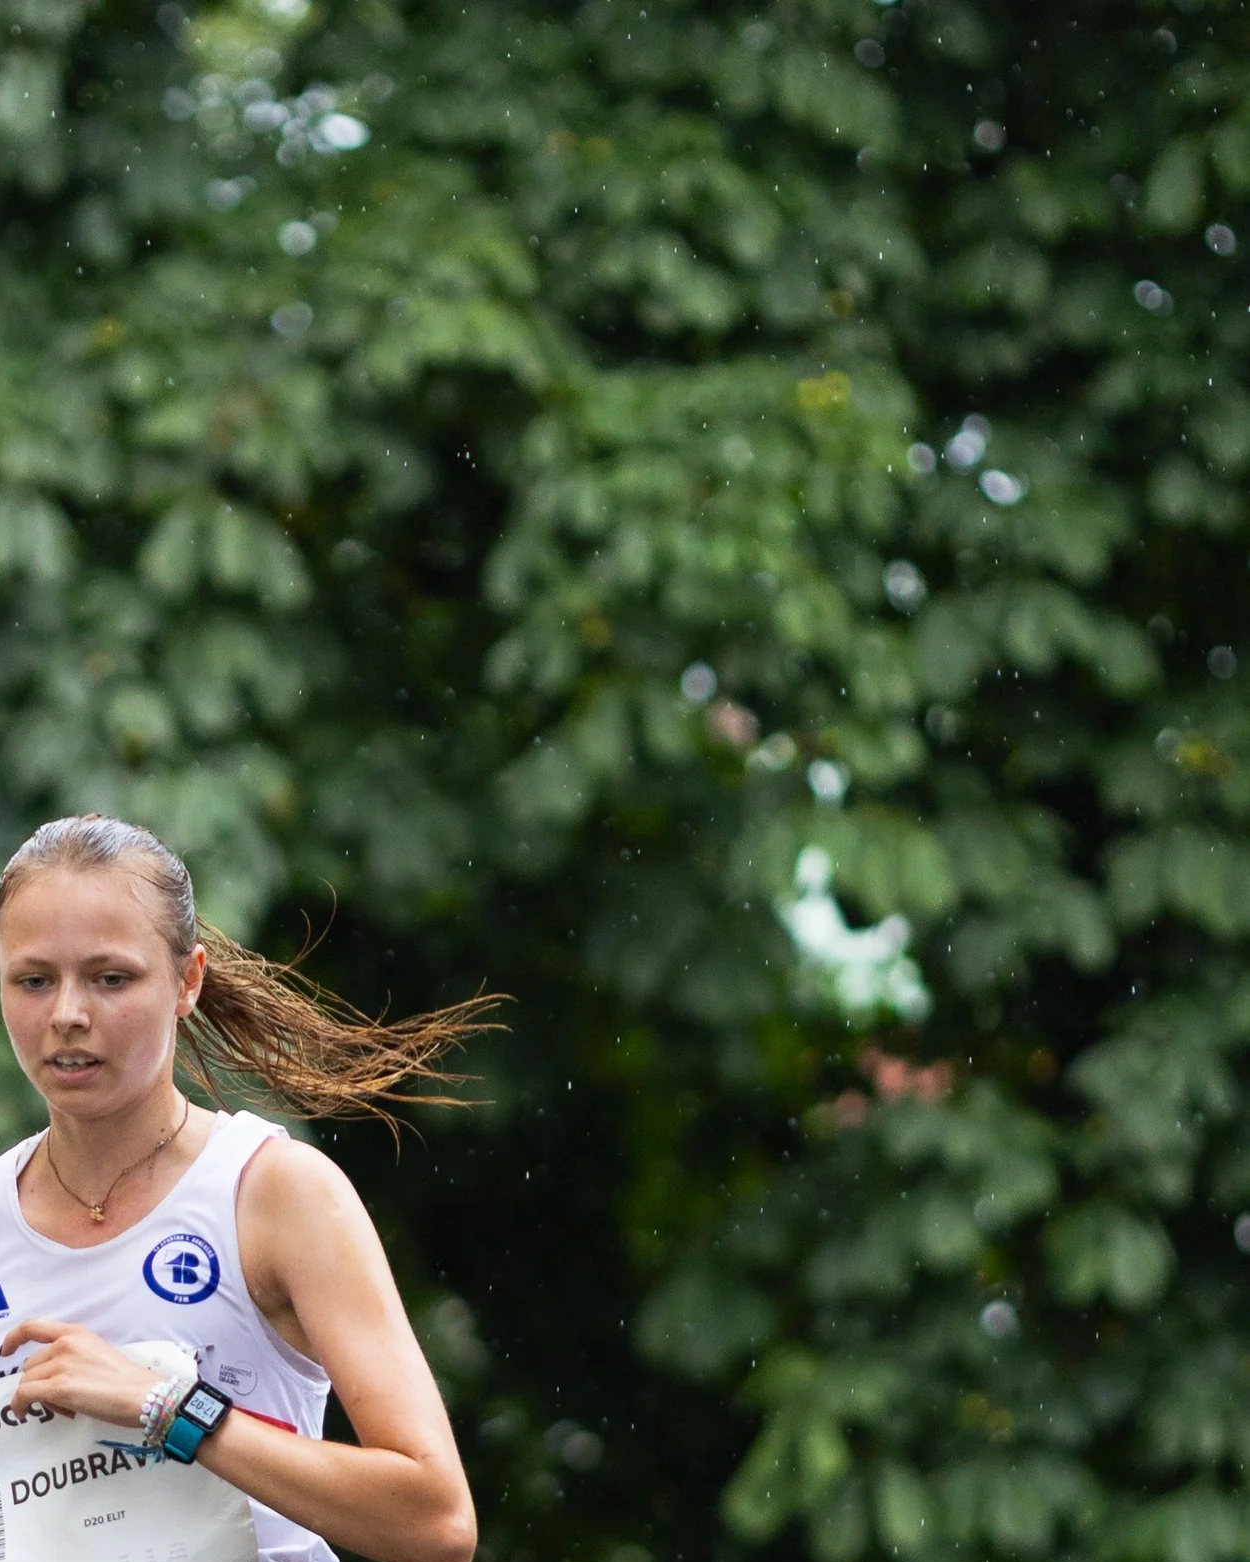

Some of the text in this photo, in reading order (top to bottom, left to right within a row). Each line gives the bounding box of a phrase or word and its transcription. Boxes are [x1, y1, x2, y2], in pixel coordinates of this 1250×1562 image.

[11, 1447, 149, 1505] DOUBRAV
[84, 1510, 127, 1527] D20 ELIT
